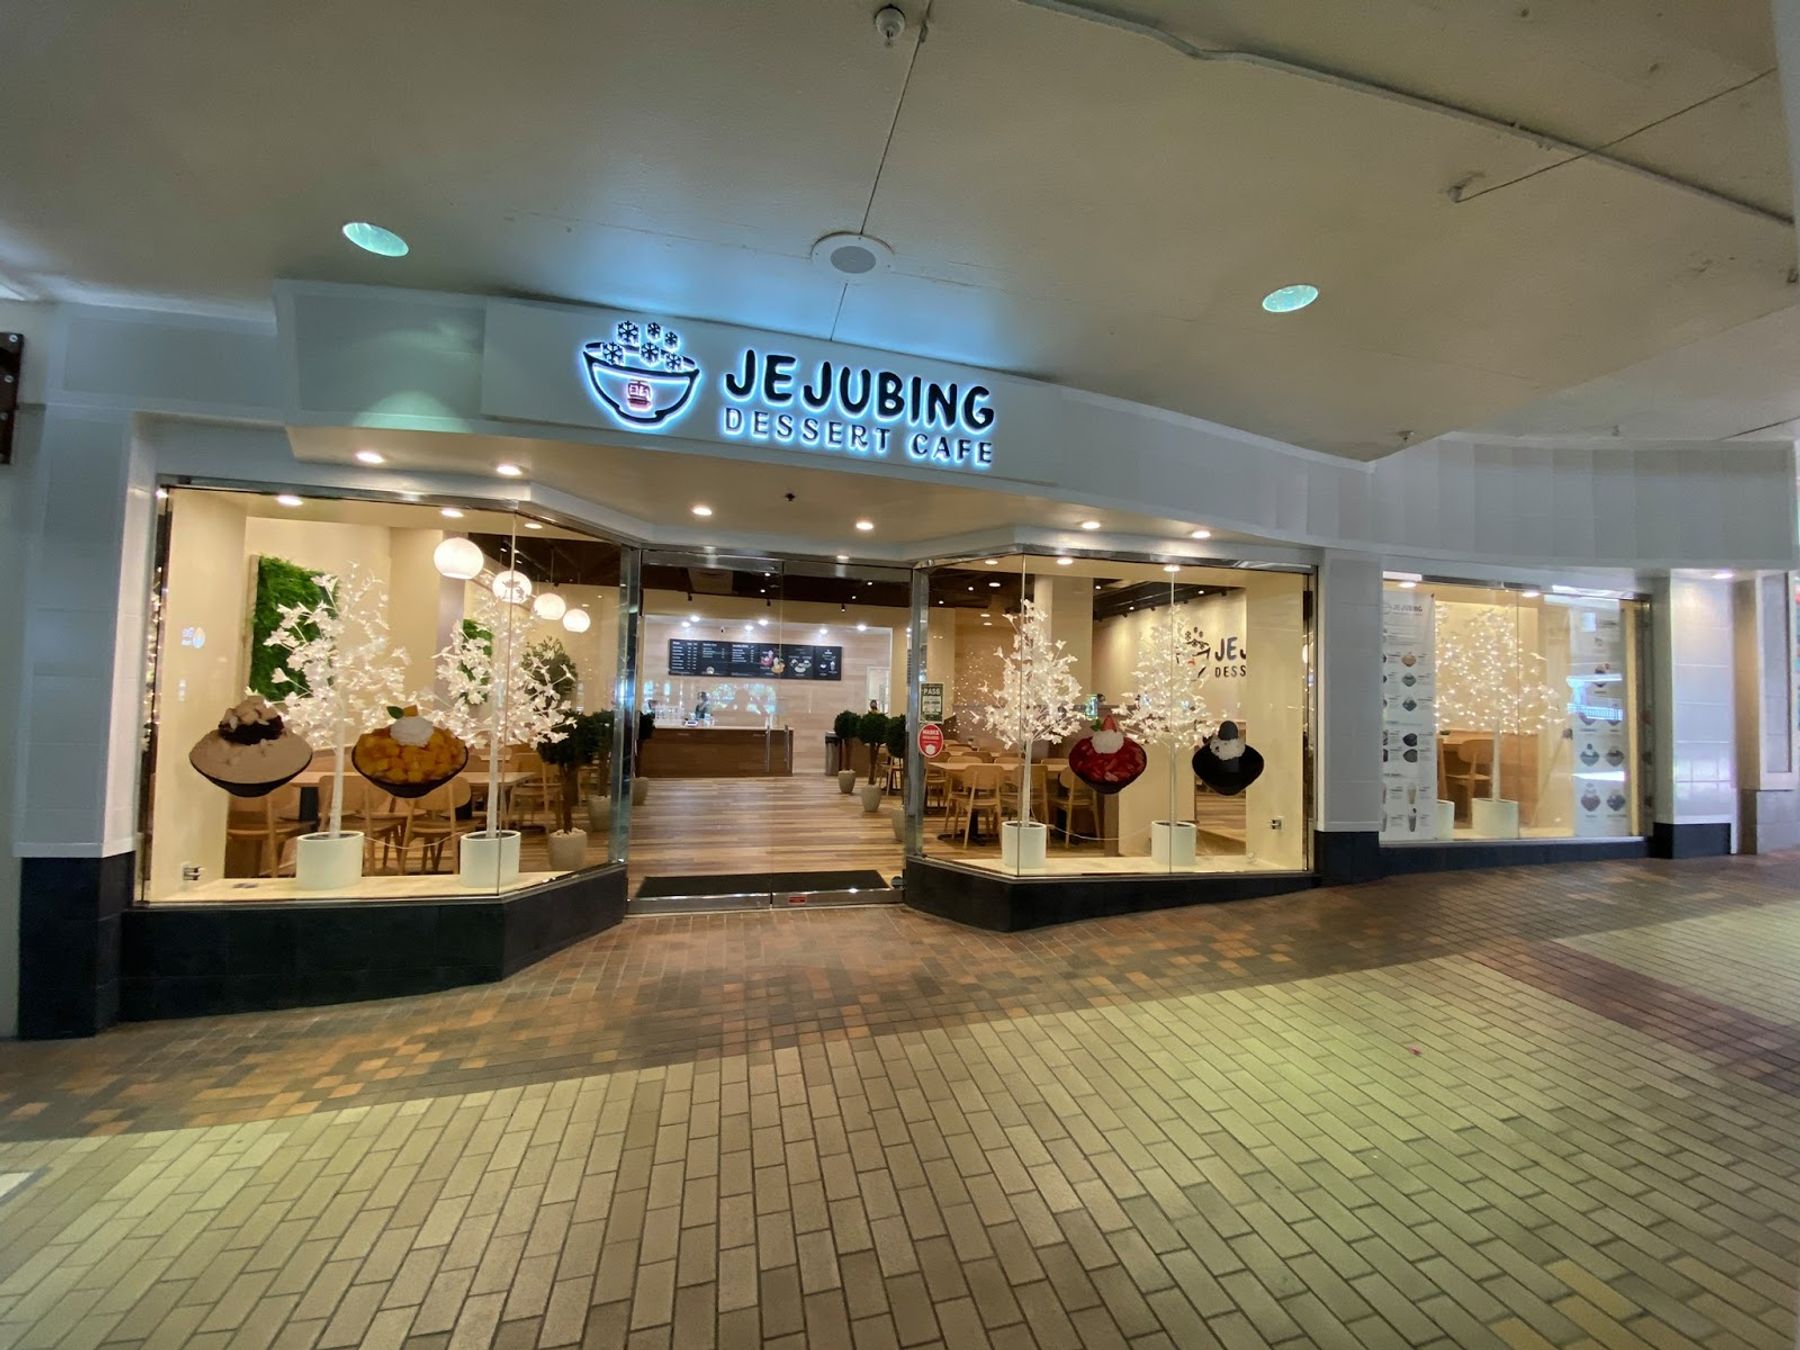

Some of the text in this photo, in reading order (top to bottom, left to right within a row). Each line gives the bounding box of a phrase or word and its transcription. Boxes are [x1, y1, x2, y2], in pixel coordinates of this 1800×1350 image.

[726, 349, 994, 429] JEJUBING
[726, 407, 992, 463] DESSERT CAFE
[1215, 665, 1246, 677] DESS
[923, 687, 941, 695] PASS
